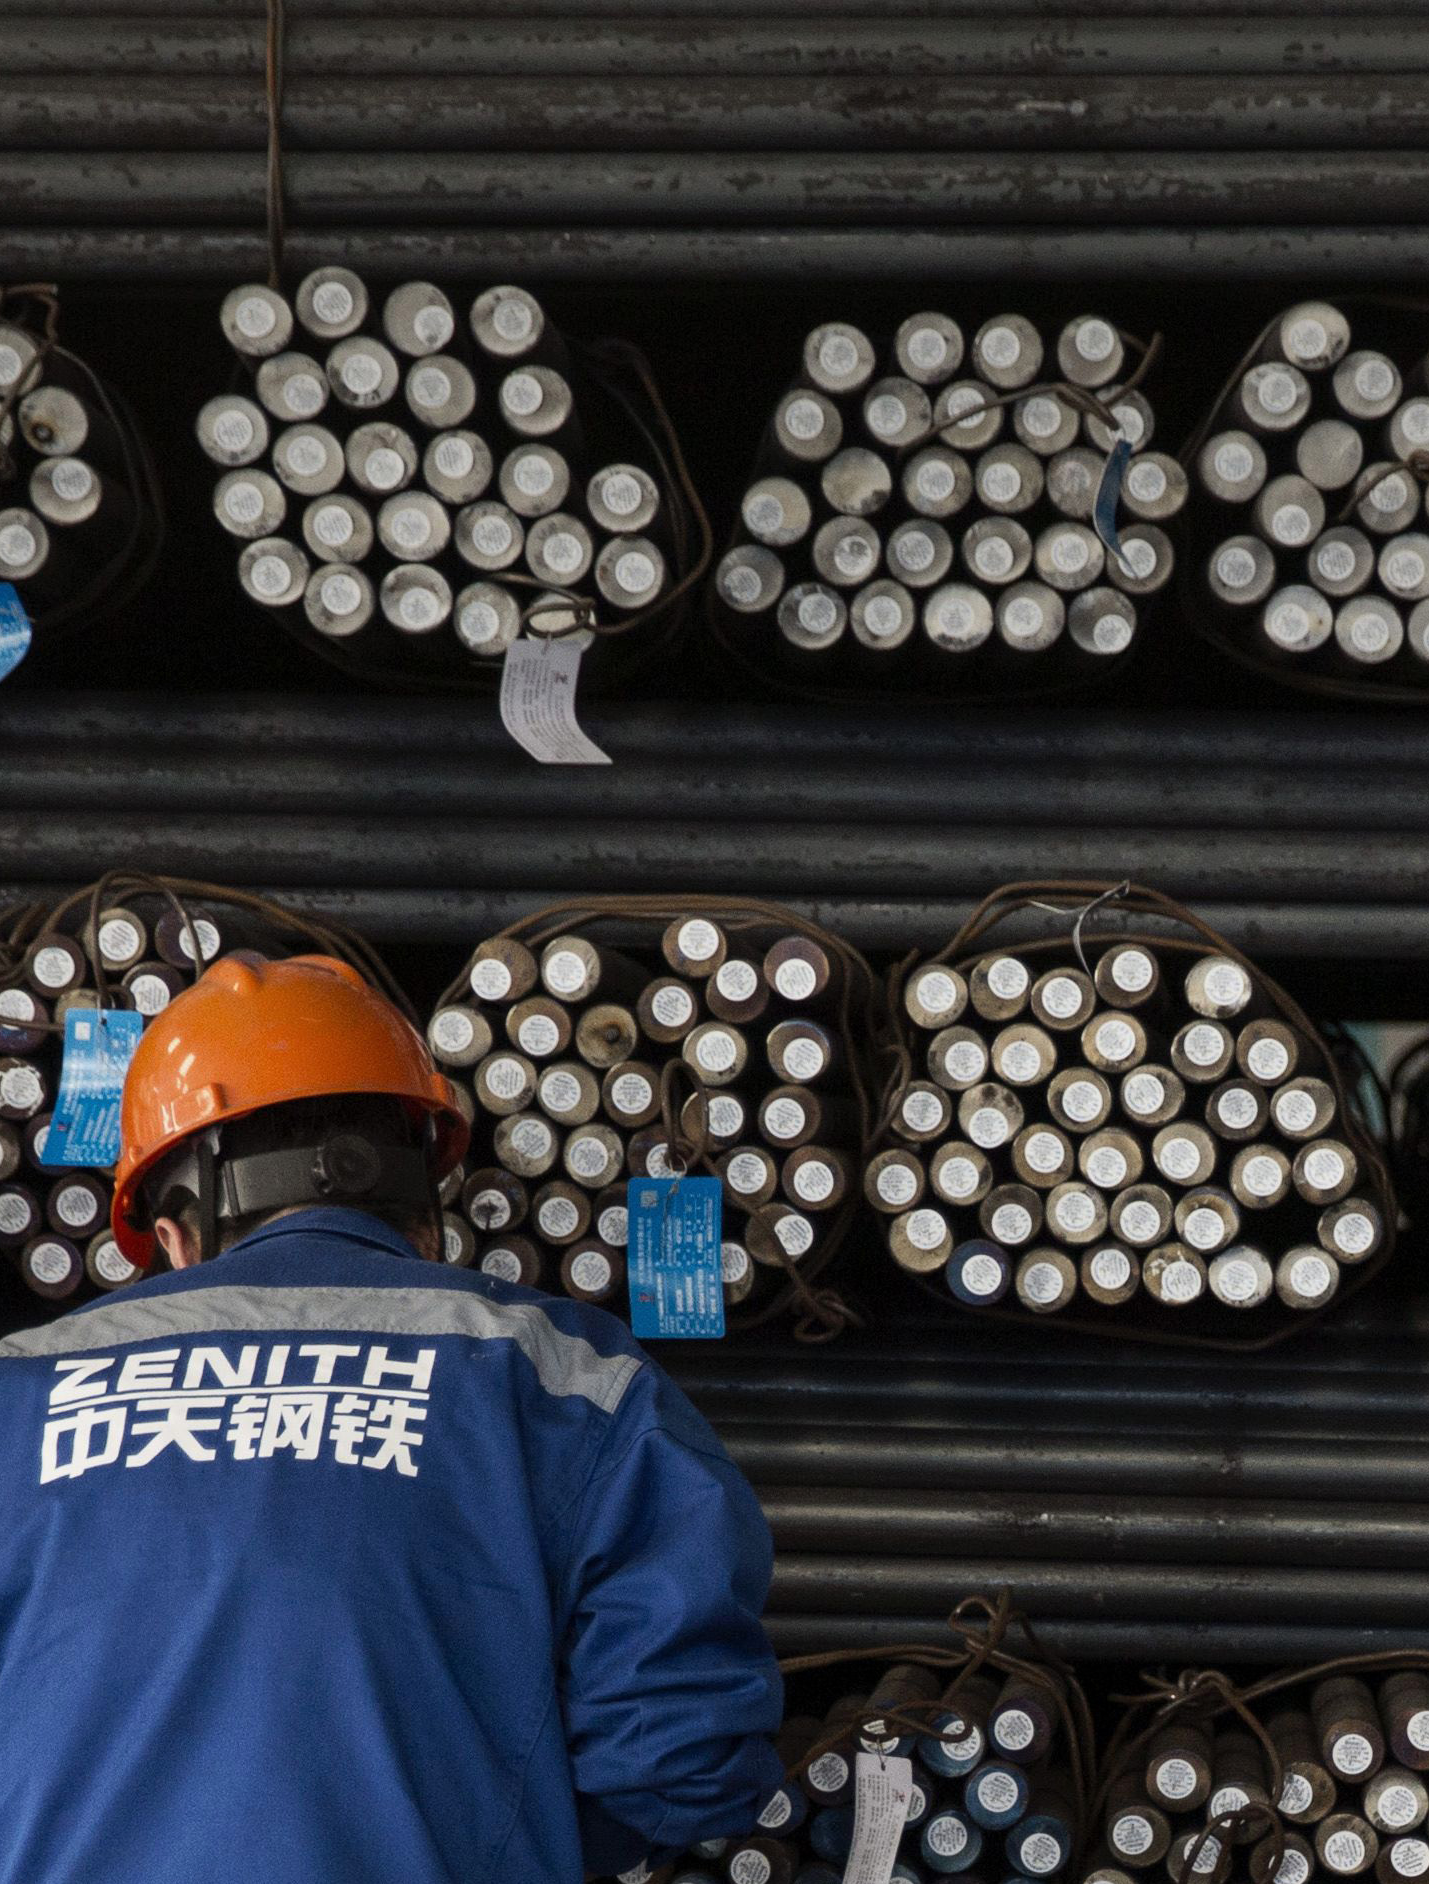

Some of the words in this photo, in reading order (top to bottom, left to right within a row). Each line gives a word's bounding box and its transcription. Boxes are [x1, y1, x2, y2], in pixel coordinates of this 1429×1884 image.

[48, 1345, 437, 1406] ZENITH
[40, 1394, 428, 1485] 中天钢铁
